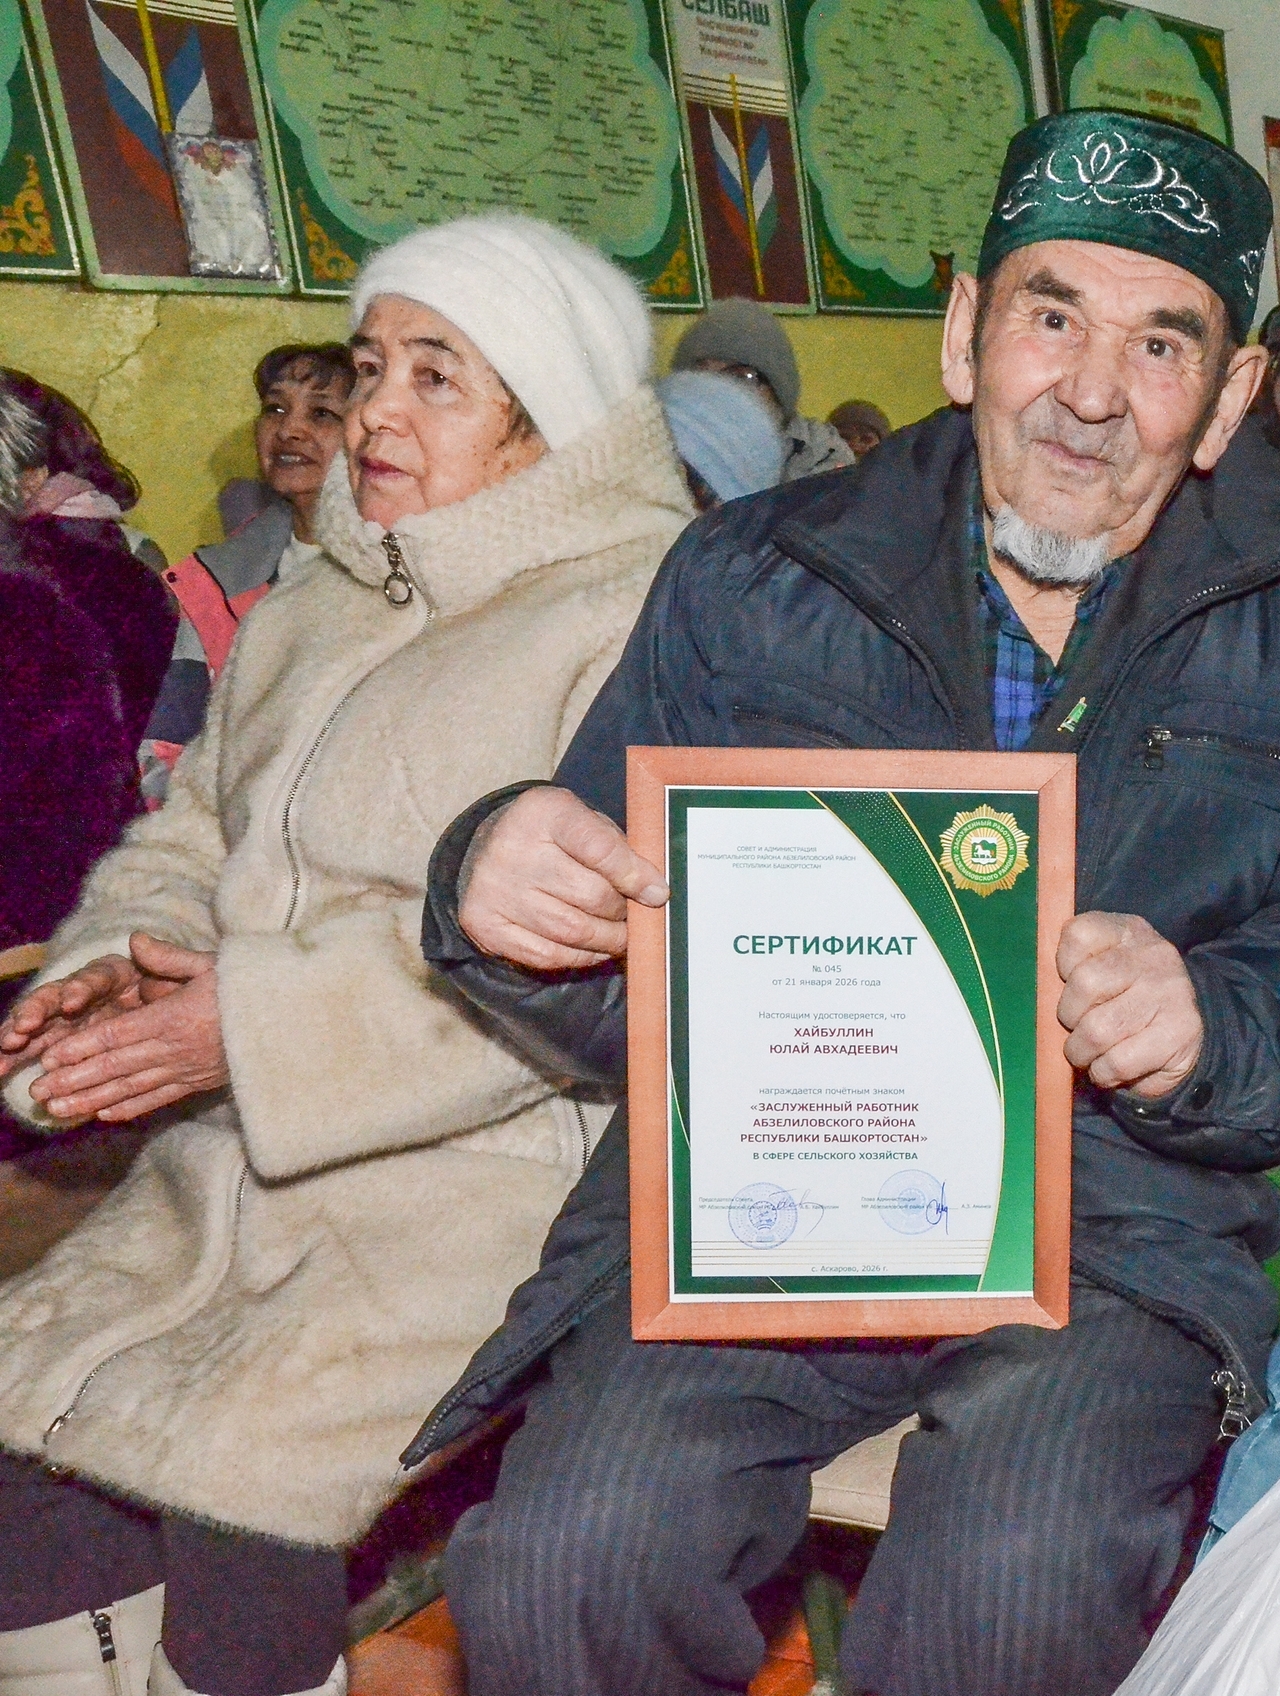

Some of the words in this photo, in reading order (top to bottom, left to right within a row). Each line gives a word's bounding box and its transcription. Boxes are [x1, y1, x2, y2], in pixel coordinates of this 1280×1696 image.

[953, 819, 992, 851] ЗАСЛУЖЕННЫЙ
[992, 822, 1015, 850] РАБОТНИК
[756, 853, 782, 861] РАЙОНА
[953, 854, 999, 882] АБЗЕЛИЛОВСКОГО
[998, 854, 1015, 877] РАЙОНА
[732, 935, 918, 956] СЕРТИФИКАТ
[812, 964, 822, 973] №
[824, 964, 842, 973] 045
[785, 977, 796, 986] 21
[799, 979, 832, 988] января
[835, 977, 858, 987] 2026
[860, 979, 881, 987] года
[758, 1011, 811, 1021] Настоящим
[812, 1012, 888, 1021] удостоверяется,
[793, 1026, 874, 1038] ХАЙБУЛЛИН
[769, 1041, 810, 1054] ЮЛАЙ
[813, 1044, 898, 1056] АВХАДЕЕВИЧ
[759, 1087, 823, 1097] награждается
[825, 1087, 870, 1096] почётным
[872, 1088, 905, 1096] знаком
[750, 1100, 853, 1112] «ЗАСЛУЖЕННЫЙ
[856, 1102, 920, 1113] РАБОТНИК
[752, 1118, 864, 1128] АБЗЕЛИЛОВСКОГО
[867, 1115, 916, 1128] РАЙОНА
[740, 1133, 820, 1143] РЕСПУБЛИКИ
[823, 1133, 928, 1143] БАШКОРТОСТАН»
[752, 1152, 760, 1160] В
[762, 1152, 795, 1161] СФЕРЕ
[797, 1151, 857, 1161] СЕЛЬСКОГО
[858, 1150, 919, 1161] ХОЗЯЙСТВА
[820, 1265, 859, 1273] Аскарово,
